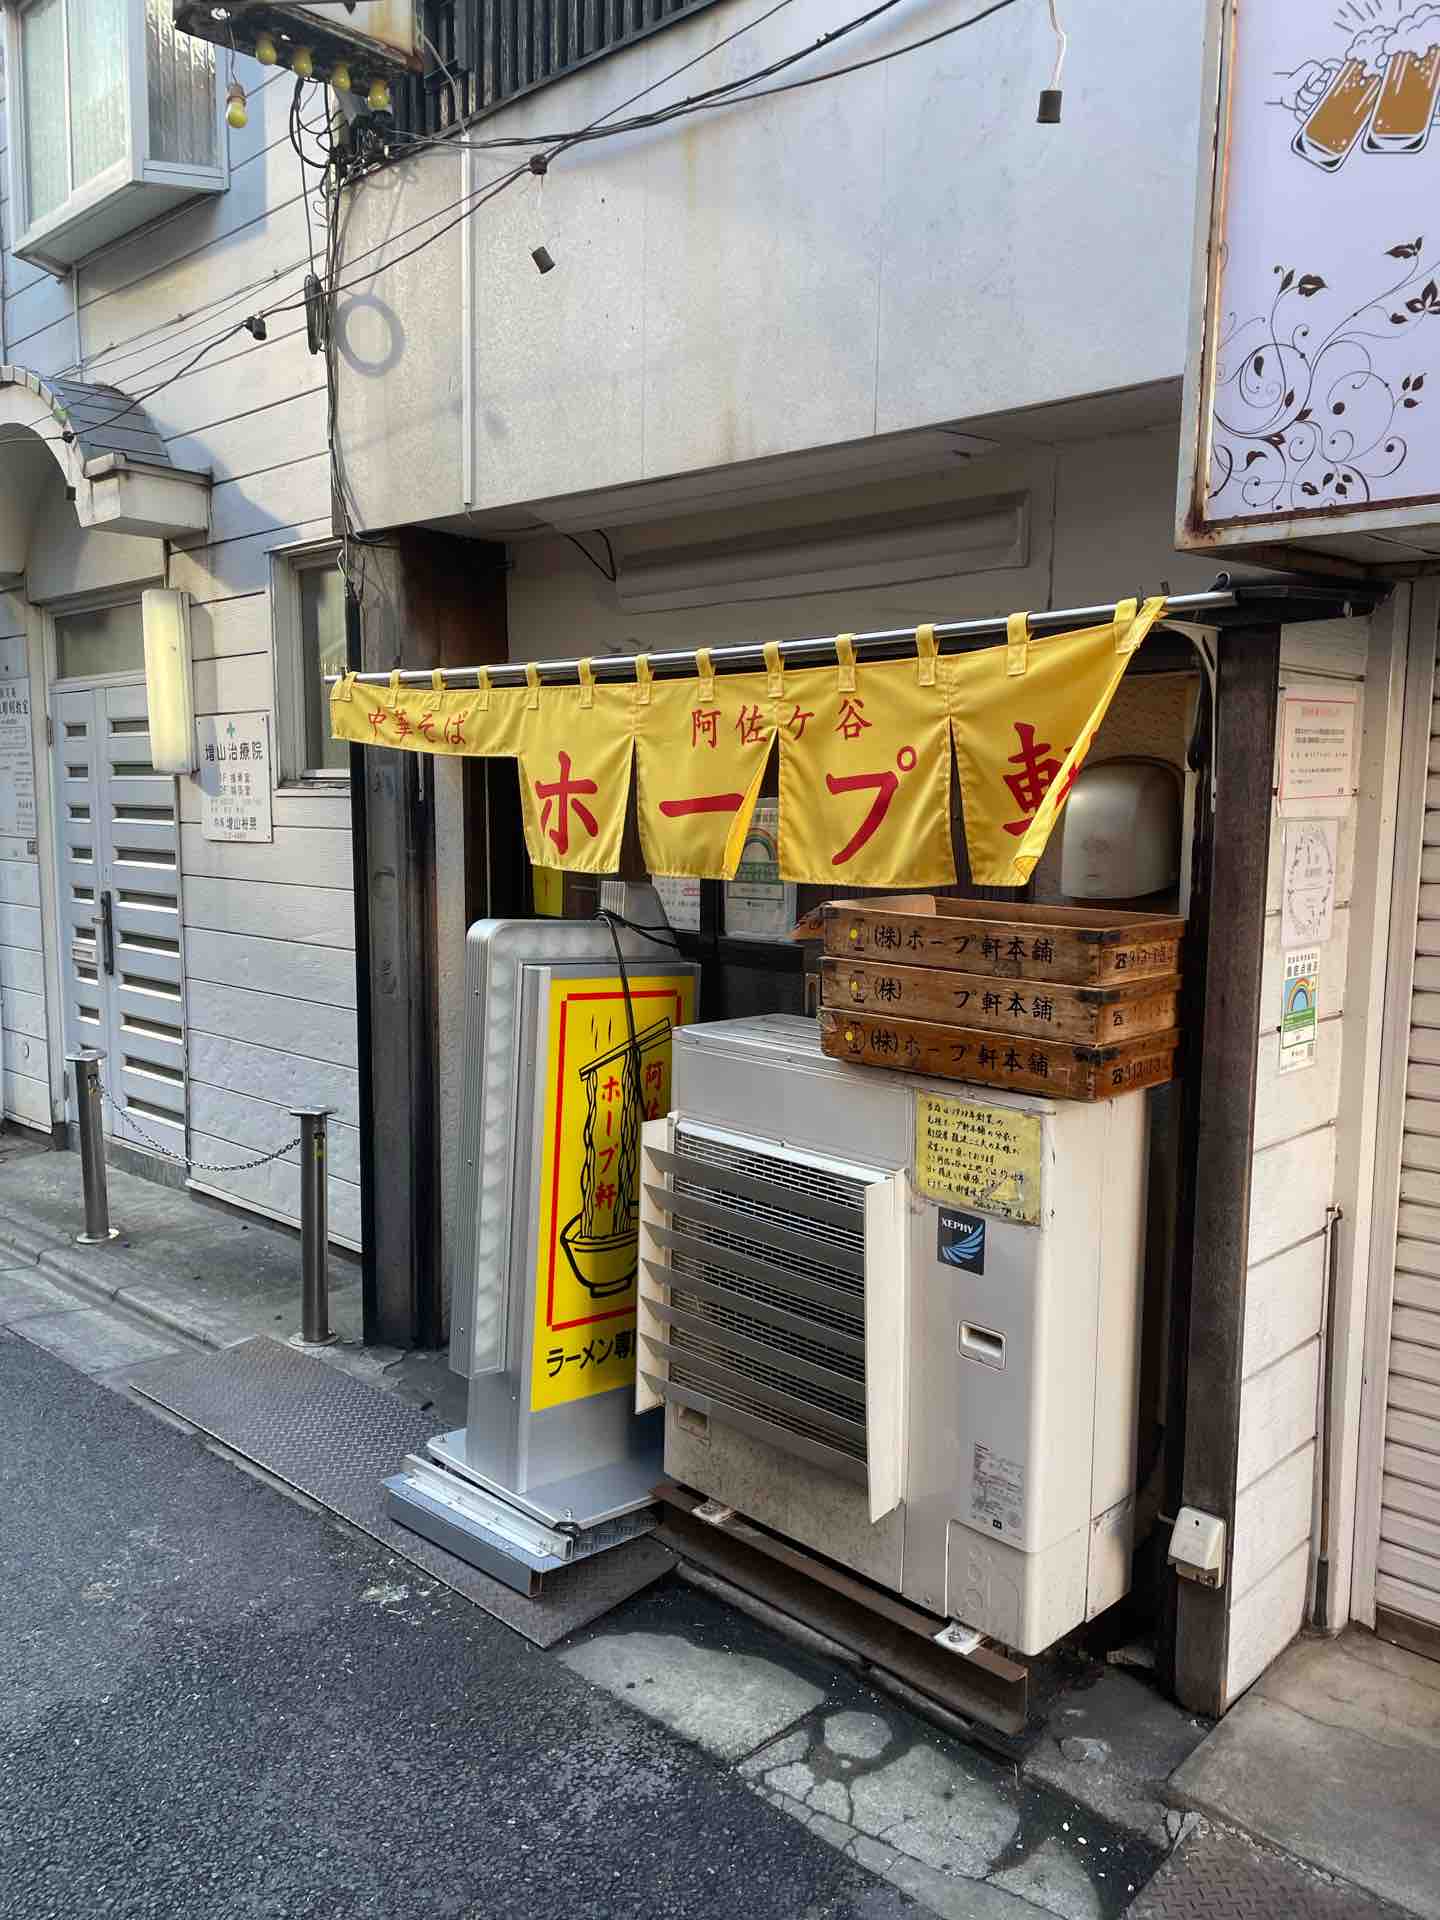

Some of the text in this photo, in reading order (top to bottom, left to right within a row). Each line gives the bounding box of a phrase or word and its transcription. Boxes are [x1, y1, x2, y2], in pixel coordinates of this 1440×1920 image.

[368, 706, 466, 744] 中華そば
[546, 1327, 637, 1378] ラーメン専
